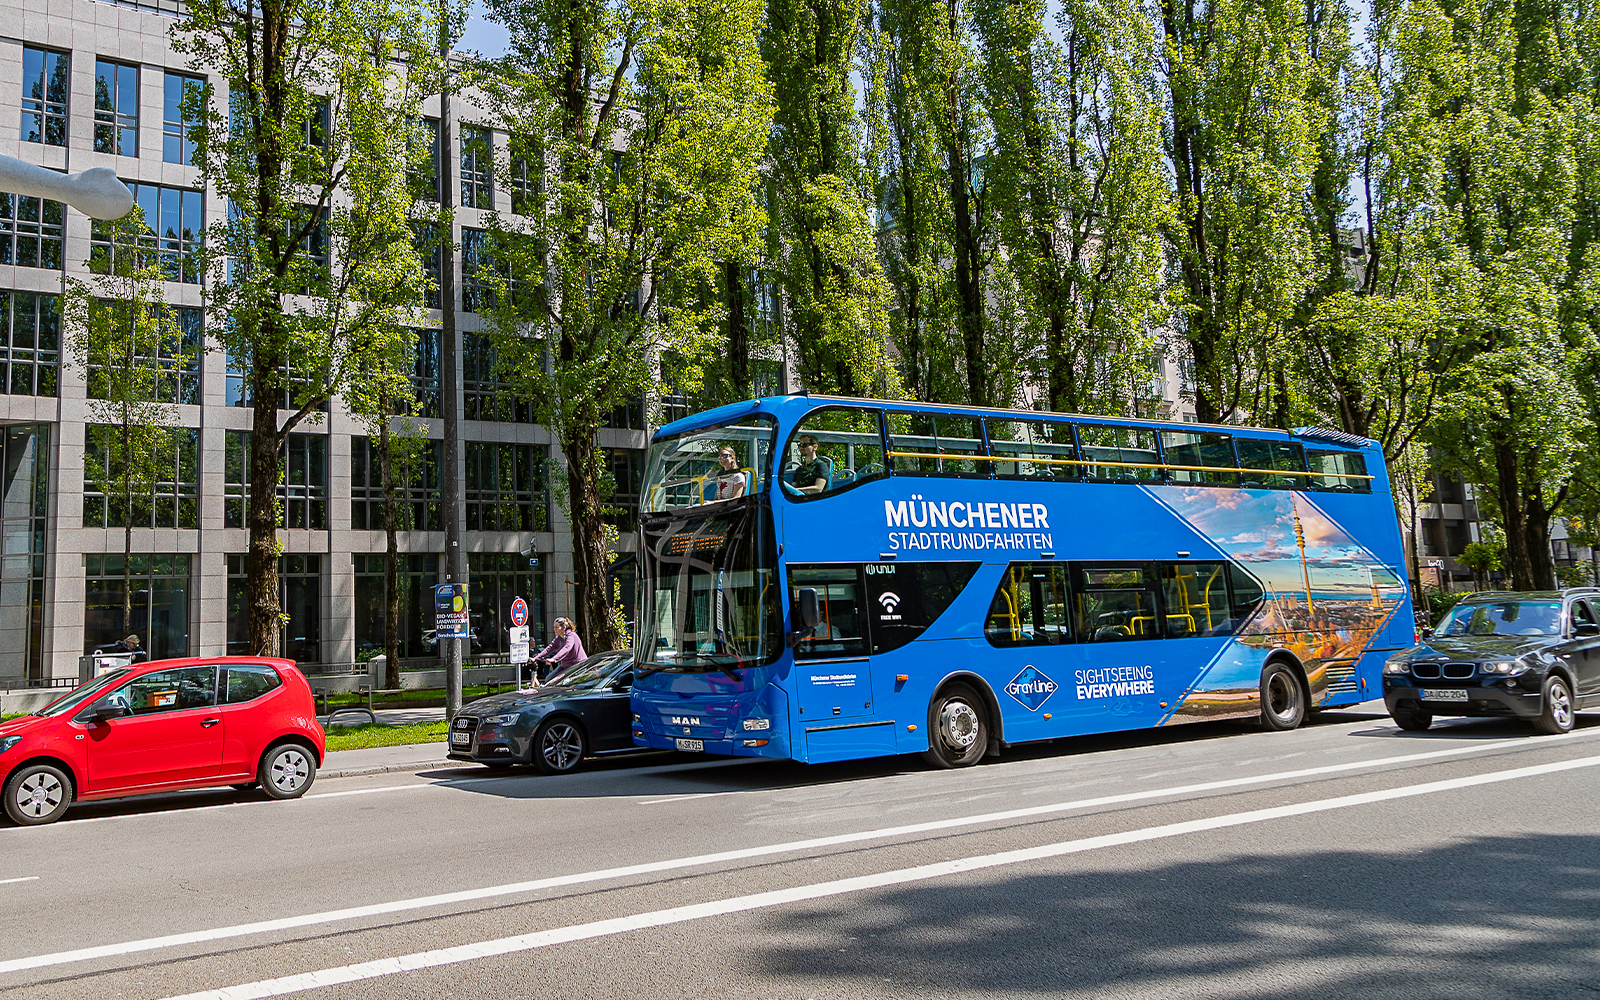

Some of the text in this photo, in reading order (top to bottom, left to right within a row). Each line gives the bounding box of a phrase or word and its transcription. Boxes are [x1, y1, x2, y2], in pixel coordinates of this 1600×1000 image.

[884, 493, 1050, 529] MÜNCHENER
[888, 532, 1053, 550] STADTRUNDFAHRTEN
[1075, 665, 1154, 685] SIGHTSEEING
[1076, 680, 1155, 700] EVERYWHERE
[672, 716, 700, 726] MAN
